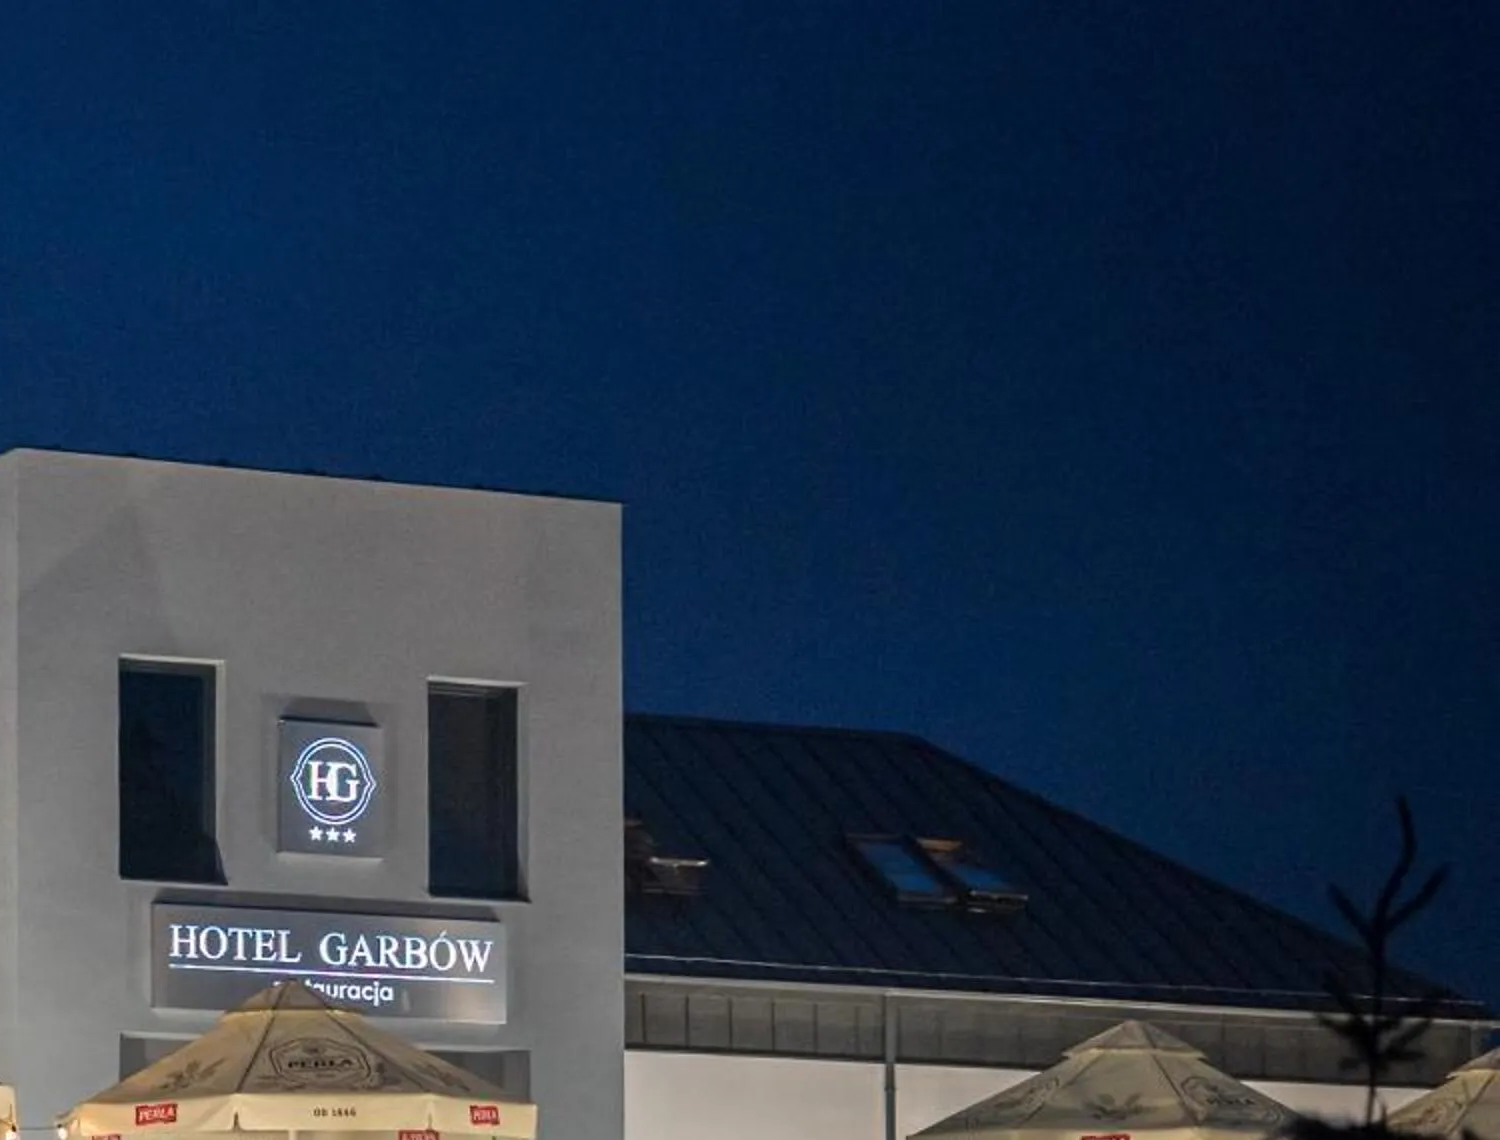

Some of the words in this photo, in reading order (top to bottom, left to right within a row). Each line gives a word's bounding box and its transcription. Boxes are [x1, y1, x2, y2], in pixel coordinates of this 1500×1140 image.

[308, 761, 360, 802] HG
[169, 925, 301, 963] HOTEL
[319, 931, 493, 973] GARBÓW
